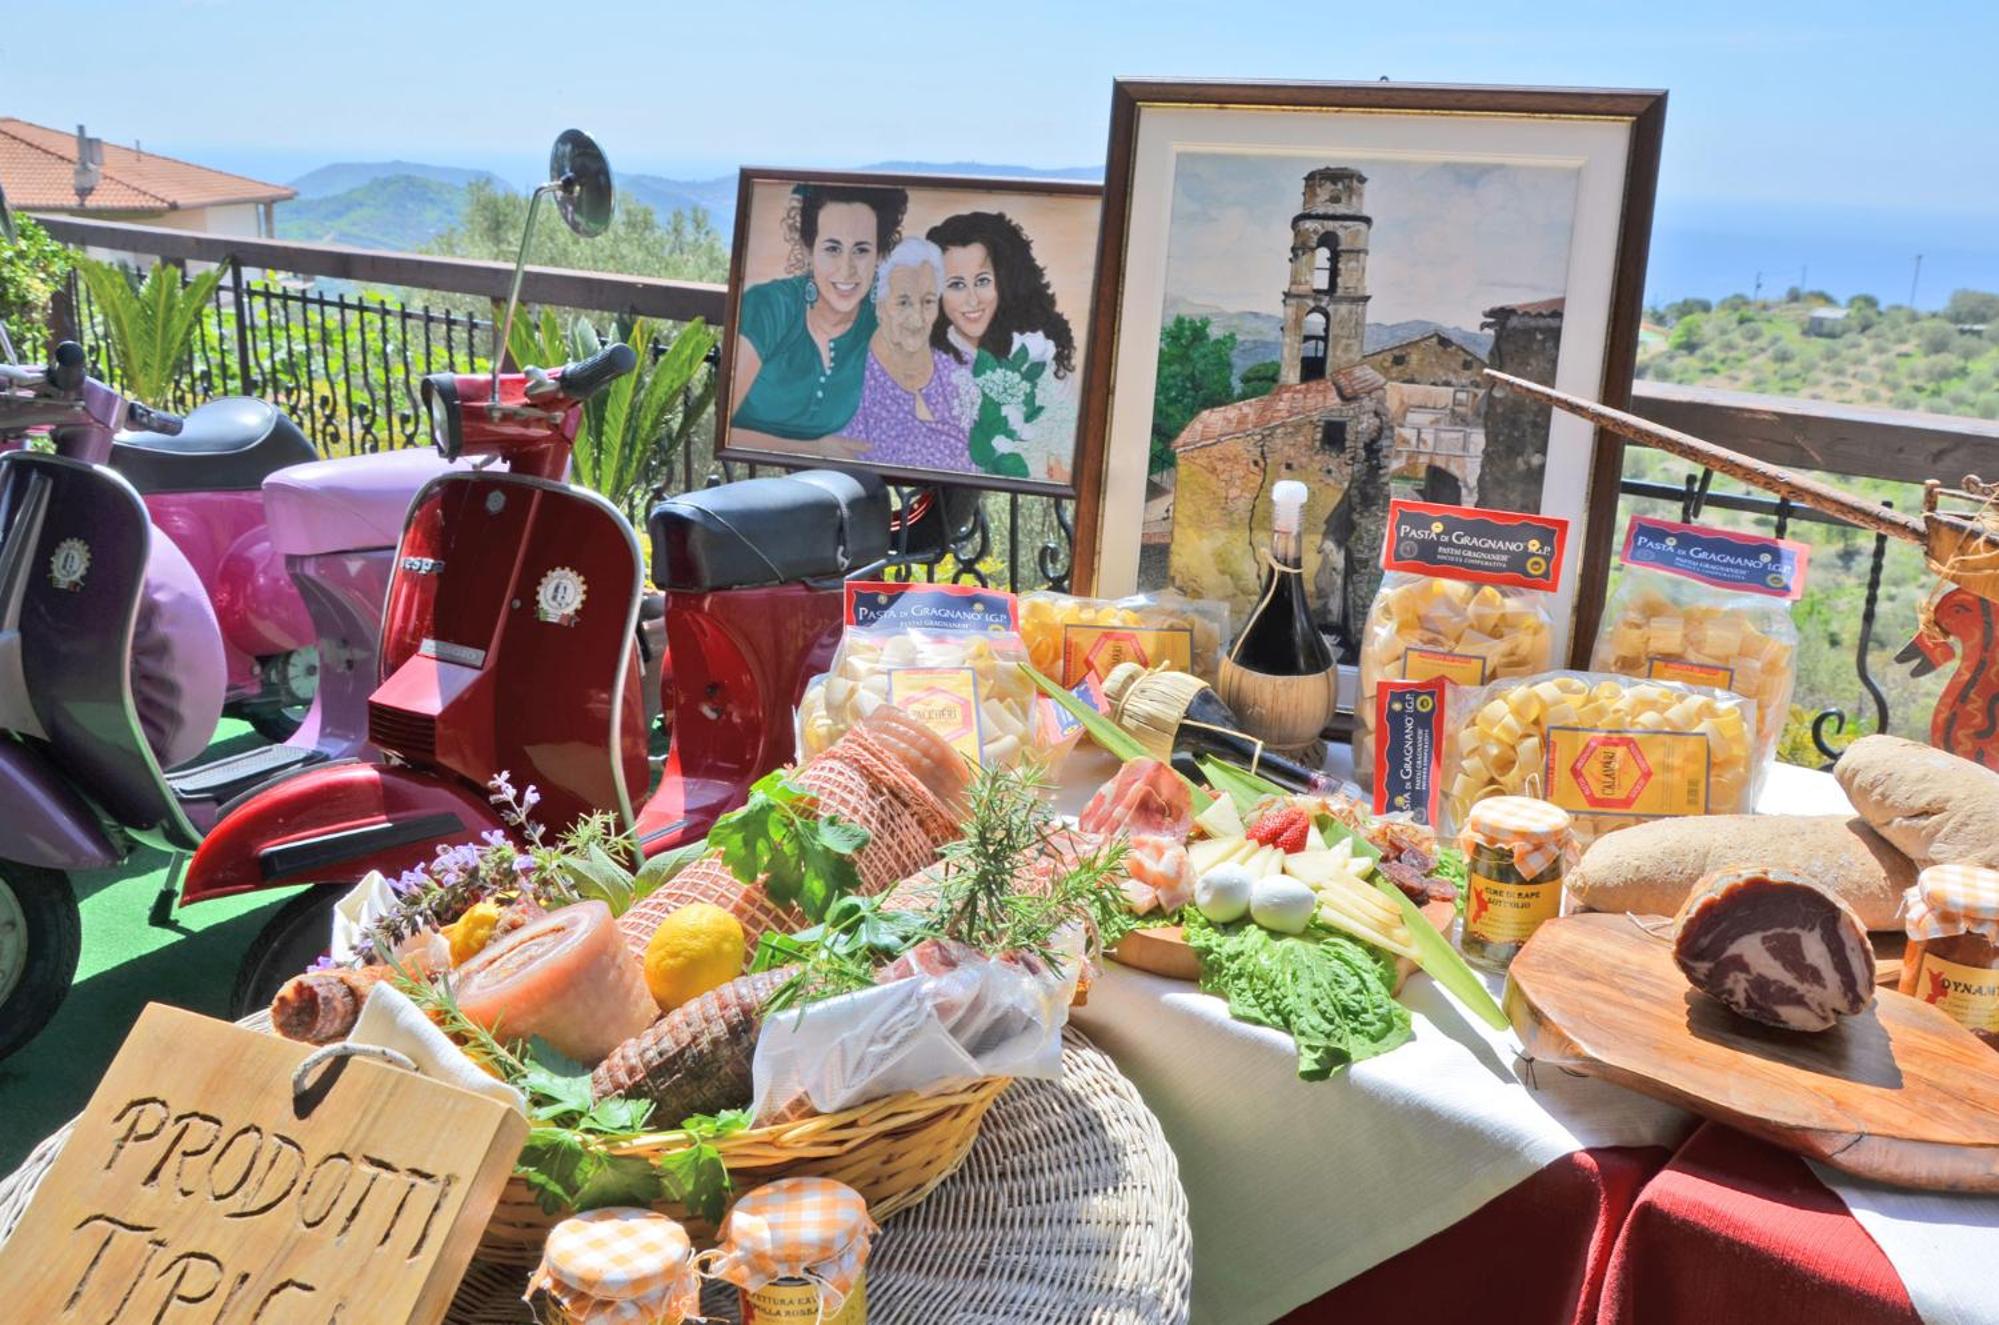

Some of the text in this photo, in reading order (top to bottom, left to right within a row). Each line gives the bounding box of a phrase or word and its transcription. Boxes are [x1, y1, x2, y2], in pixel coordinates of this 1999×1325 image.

[1399, 525, 1437, 541] PASTA
[1440, 534, 1449, 542] DI
[1451, 531, 1524, 552] GRAGNANO
[1636, 535, 1675, 553] PASTA
[1689, 547, 1763, 569] GRAGNANO
[858, 607, 897, 620] PASTA
[910, 605, 981, 621] GRAGNANO
[1400, 716, 1414, 780] GRAGNANO
[1517, 891, 1541, 899] RAPE
[1941, 977, 1999, 997] DYNAM
[104, 1096, 460, 1264] PRODOTTI
